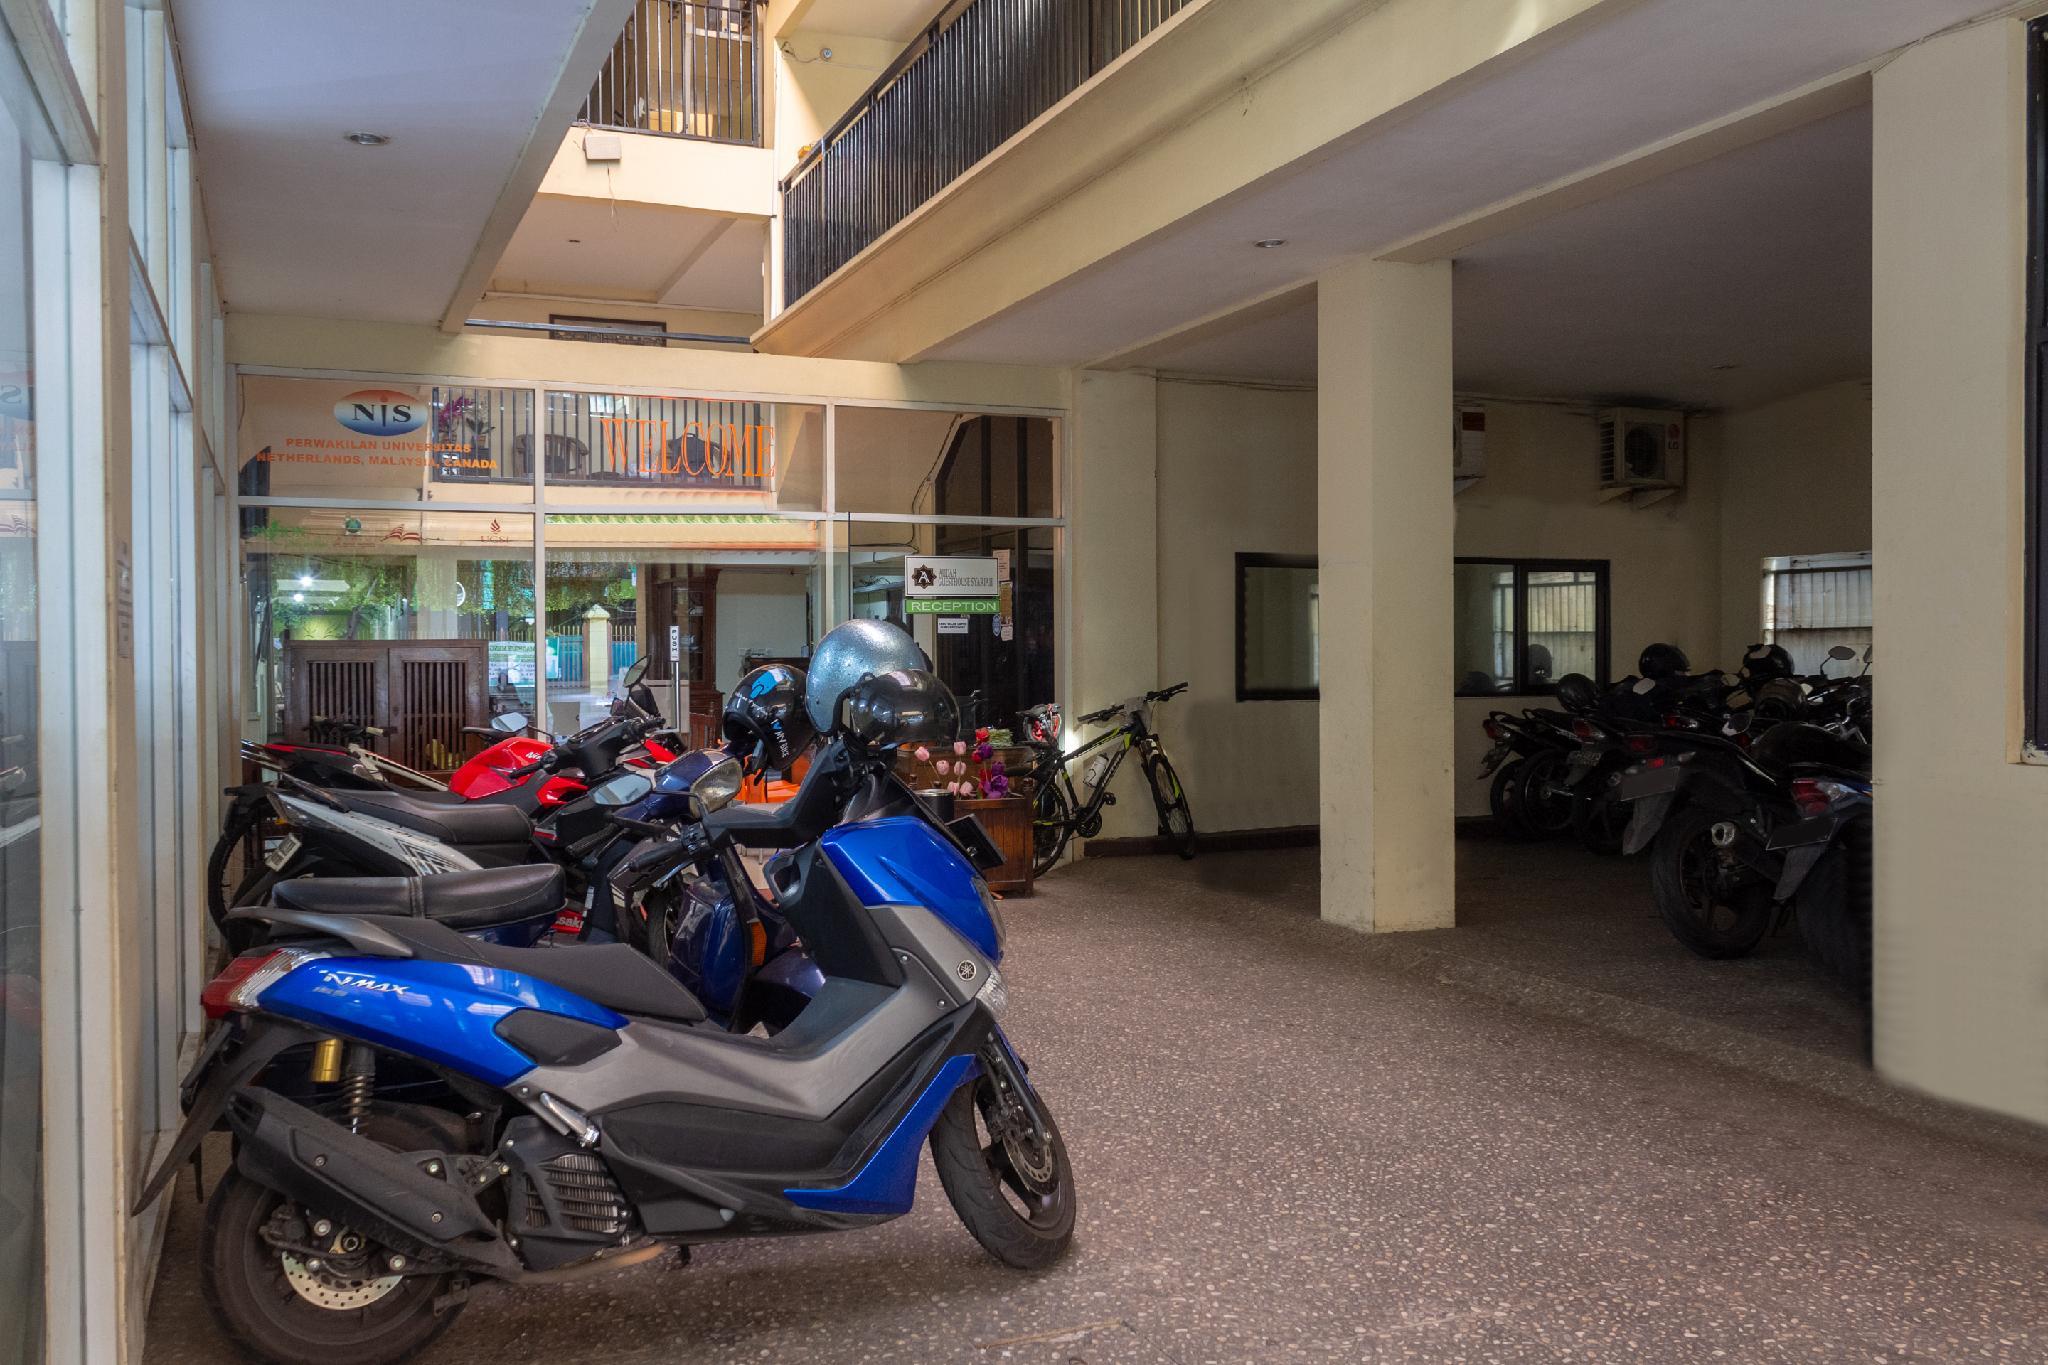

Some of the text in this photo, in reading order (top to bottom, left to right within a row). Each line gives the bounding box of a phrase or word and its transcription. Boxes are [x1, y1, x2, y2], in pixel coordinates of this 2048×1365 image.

[285, 437, 472, 453] PERWAKILAN UNIVERSITAS
[600, 418, 776, 478] WELCOME
[256, 452, 497, 469] NETHERLANDS, MALAYSIA, CANADA
[911, 602, 997, 611] RECEPTION
